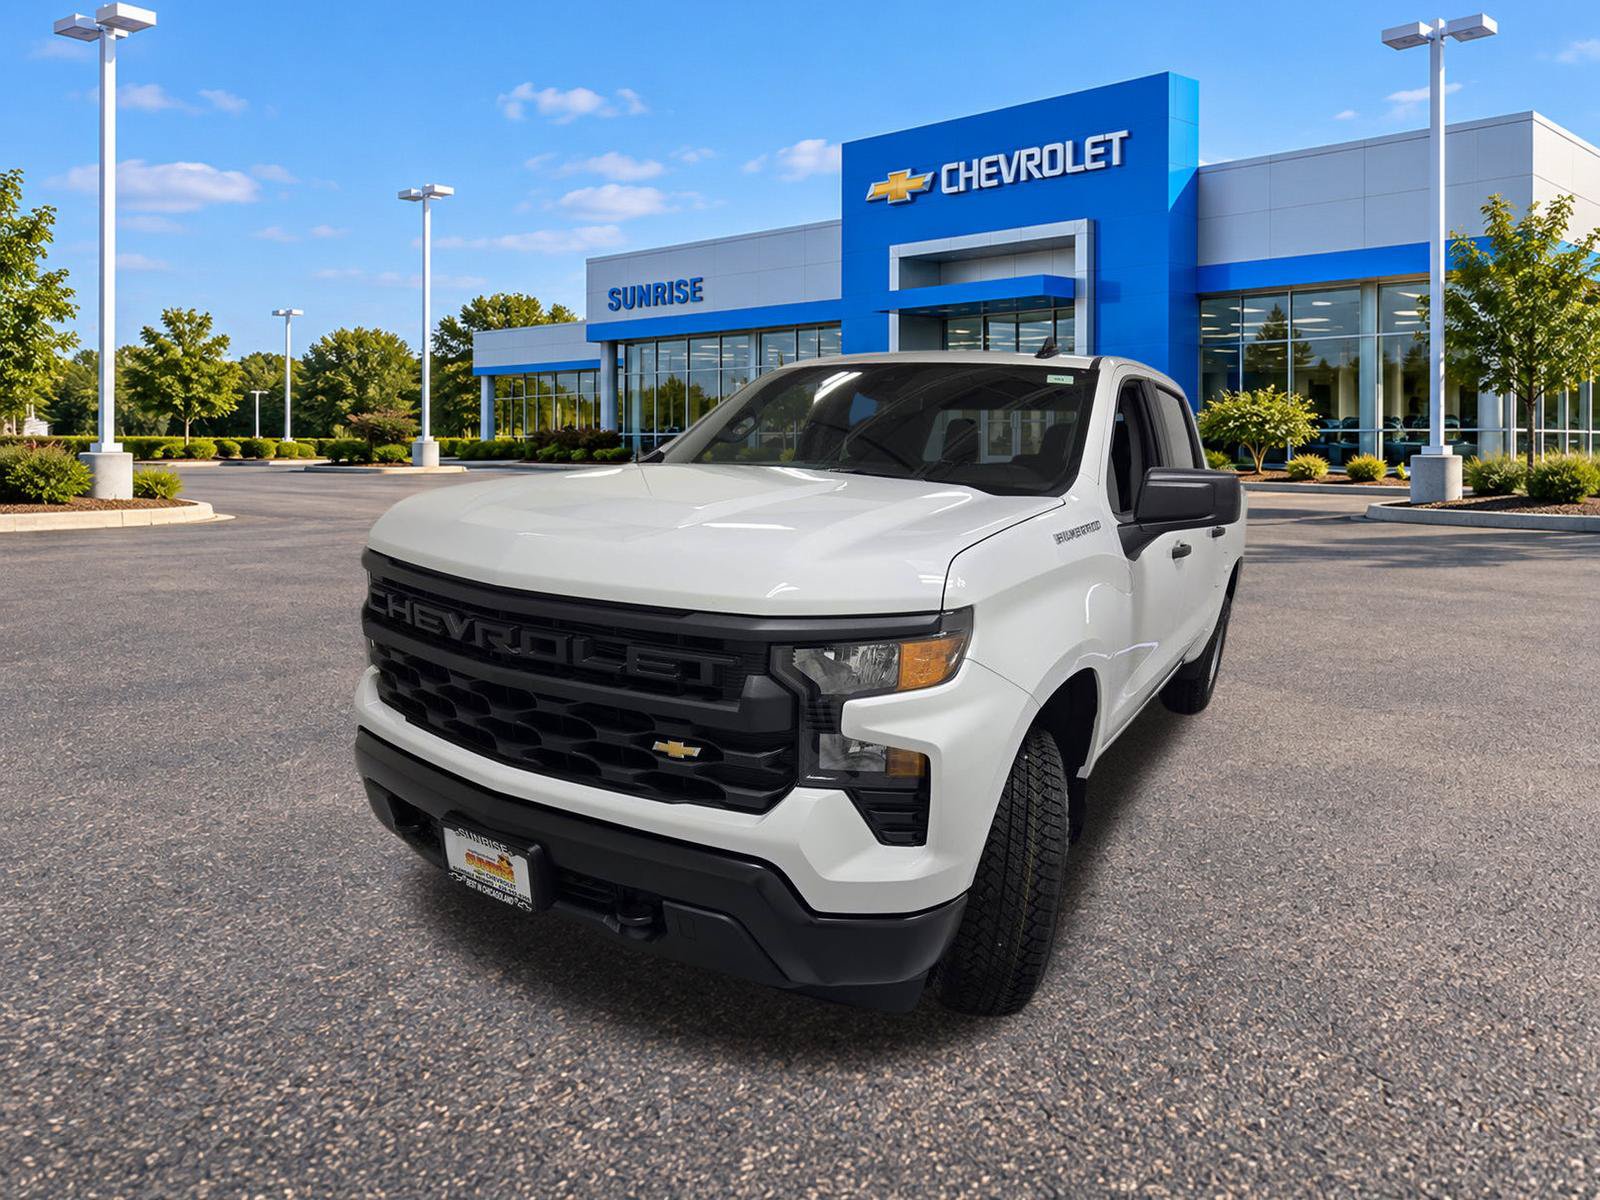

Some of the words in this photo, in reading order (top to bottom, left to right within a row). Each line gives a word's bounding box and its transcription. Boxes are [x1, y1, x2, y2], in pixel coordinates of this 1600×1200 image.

[941, 130, 1129, 194] CHEVROLET
[608, 277, 704, 311] SUNRISE
[1053, 520, 1101, 545] SILVERADO
[366, 585, 742, 686] CHEVROLET
[457, 828, 508, 853] SUNRISE
